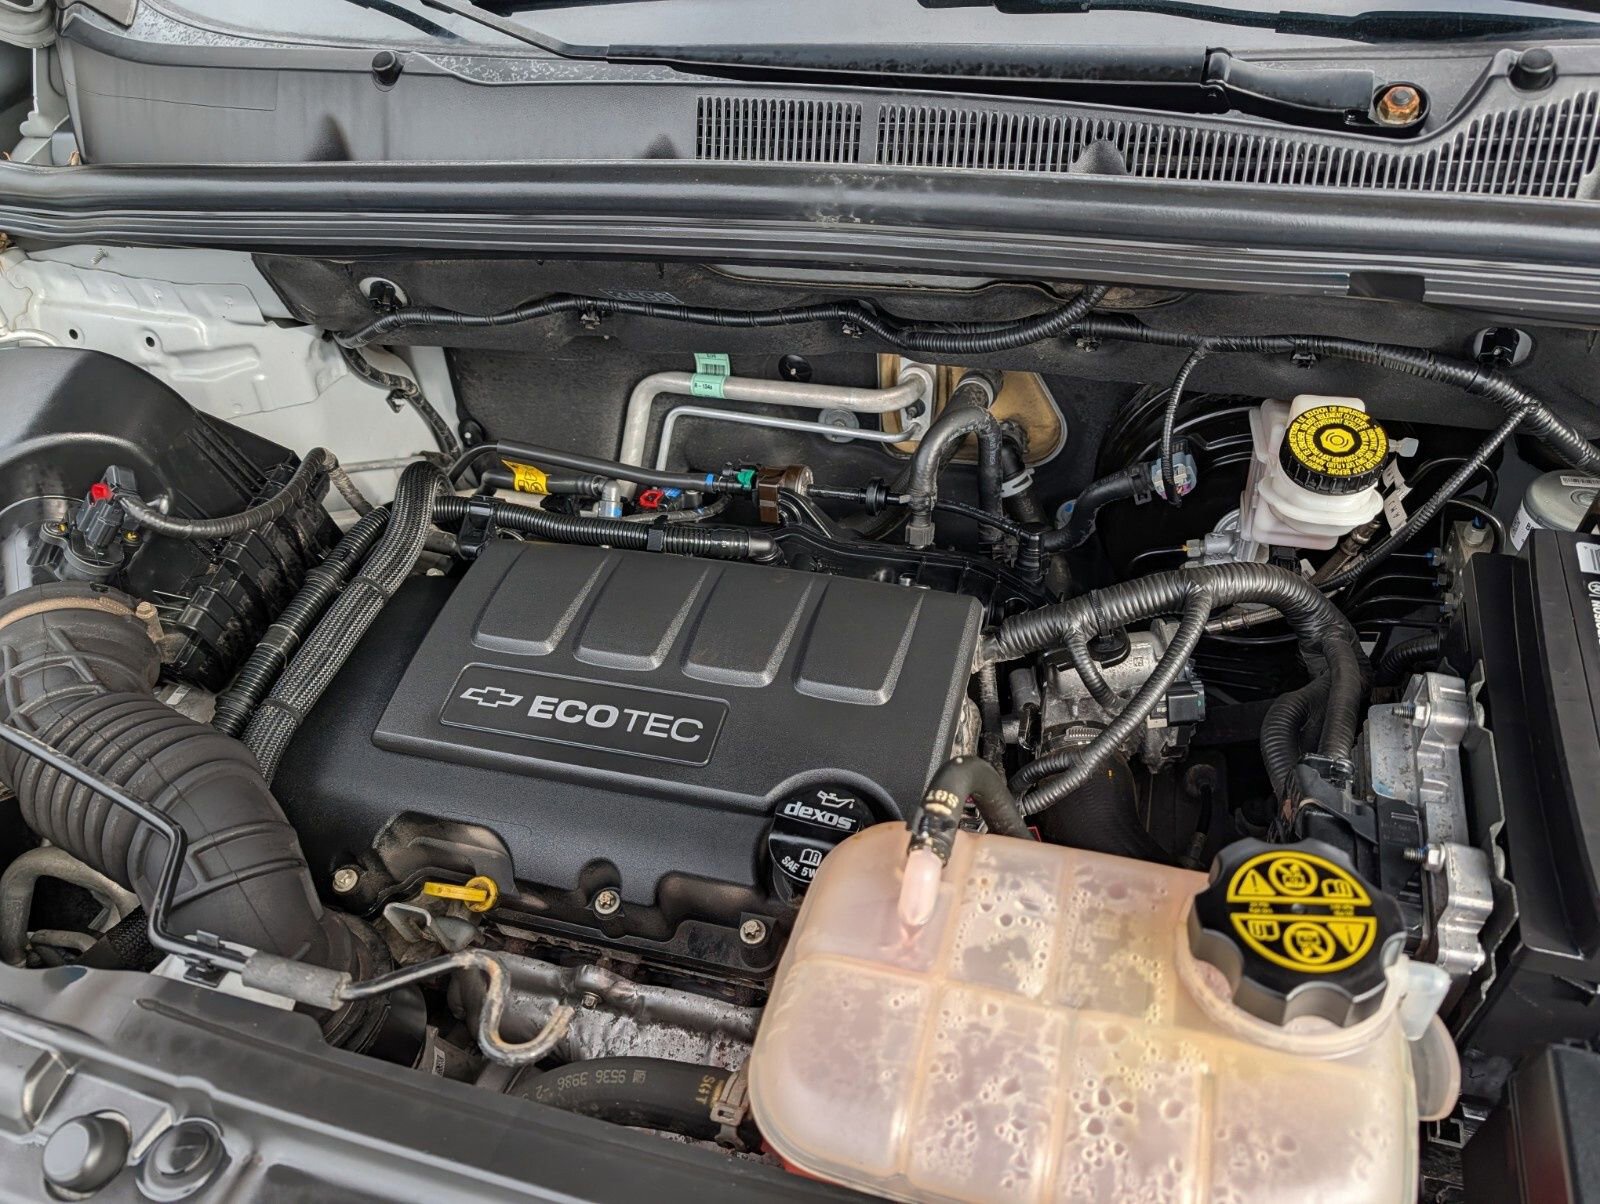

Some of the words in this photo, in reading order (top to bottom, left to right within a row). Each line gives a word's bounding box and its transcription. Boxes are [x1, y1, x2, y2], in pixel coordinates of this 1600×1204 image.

[527, 695, 704, 744] ECOTEC
[784, 801, 855, 830] dexos
[781, 855, 800, 873] SAE
[596, 1069, 626, 1085] 9536
[695, 1074, 716, 1105] SGT
